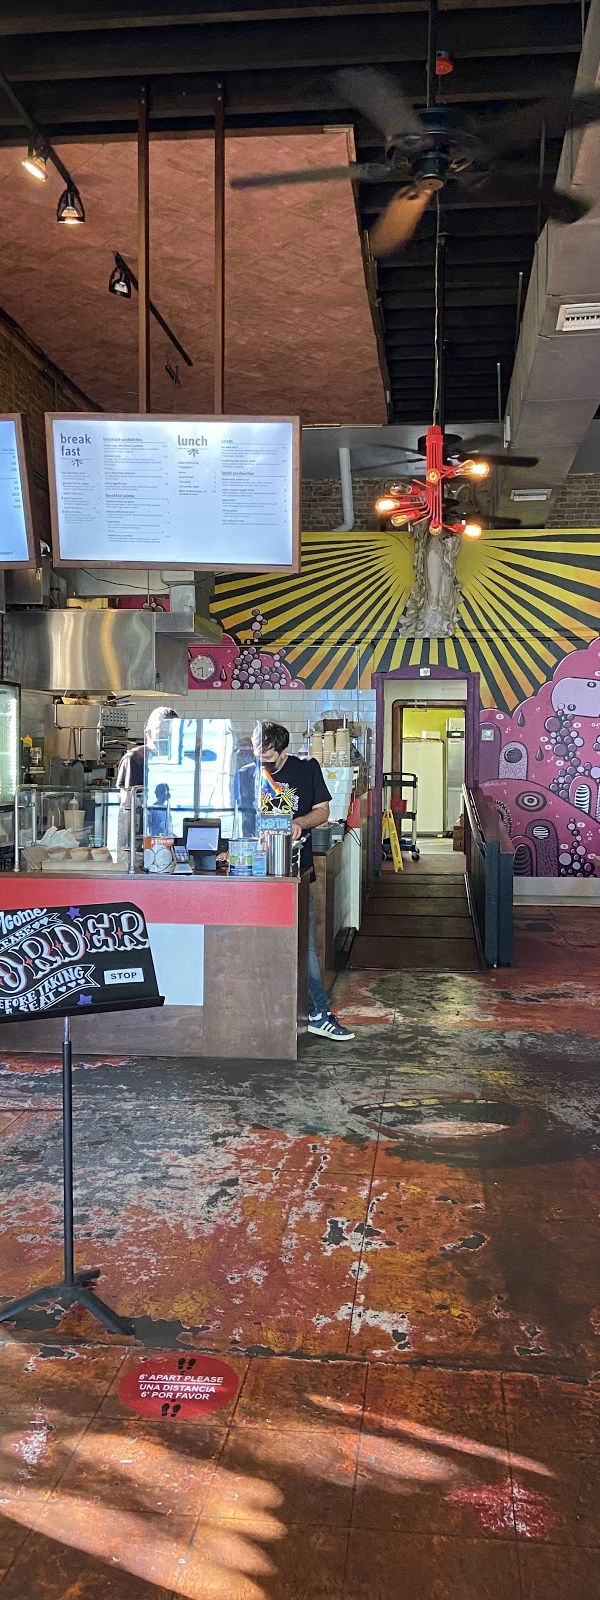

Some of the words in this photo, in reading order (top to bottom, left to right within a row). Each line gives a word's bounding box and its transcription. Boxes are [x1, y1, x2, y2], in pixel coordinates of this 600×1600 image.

[60, 433, 91, 445] break
[177, 435, 208, 446] lunch
[61, 446, 81, 457] fast
[0, 910, 150, 993] ORDER
[110, 972, 137, 980] STOP
[0, 990, 37, 1009] EFORE
[36, 967, 85, 995] TAKING
[139, 1373, 148, 1381] 6'
[148, 1374, 182, 1382] APART
[184, 1375, 224, 1383] PLEASE
[139, 1383, 160, 1391] UNA
[162, 1384, 216, 1393] DISTANCIA
[151, 1391, 173, 1399] POR
[175, 1392, 210, 1400] FAVOR
